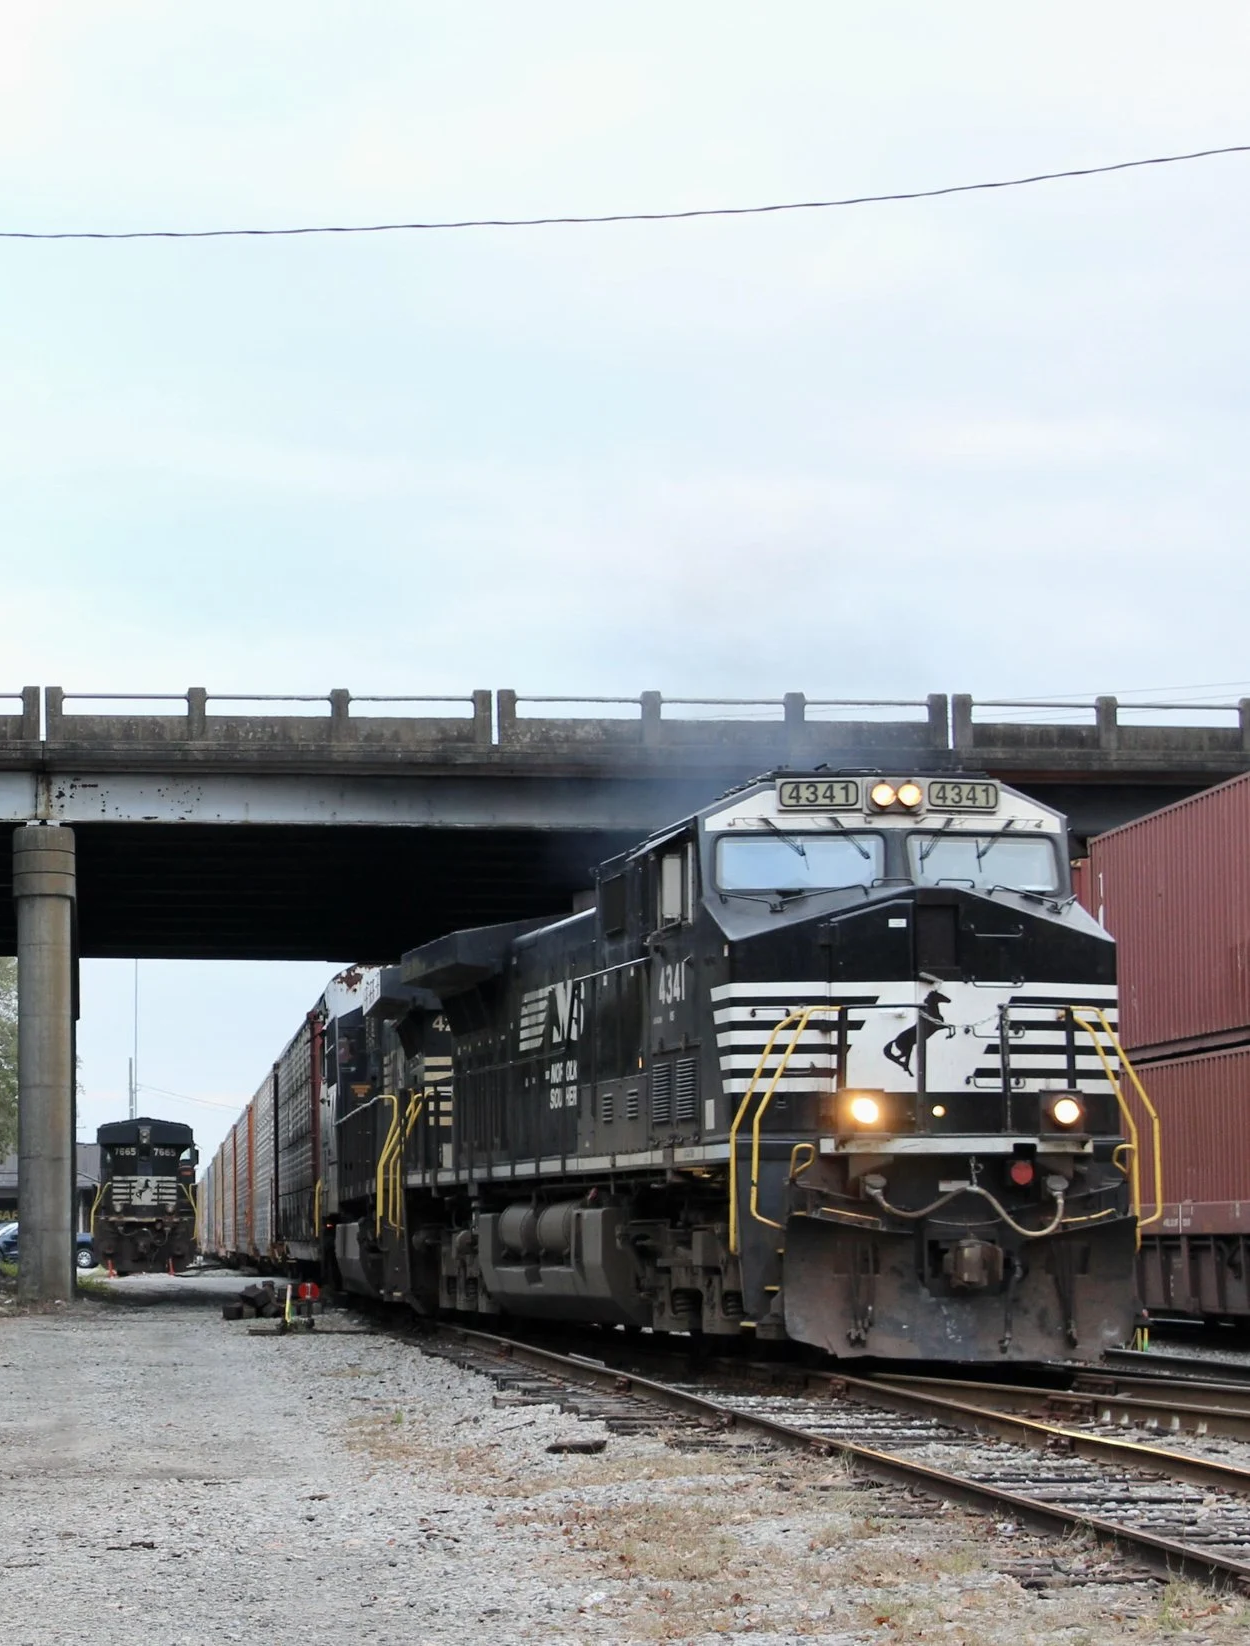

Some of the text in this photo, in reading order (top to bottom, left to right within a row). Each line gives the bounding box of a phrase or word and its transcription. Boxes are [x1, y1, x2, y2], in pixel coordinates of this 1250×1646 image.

[788, 783, 851, 804] 4341
[934, 784, 991, 806] 4341
[658, 961, 686, 1005] 4341
[114, 1147, 137, 1156] 7665
